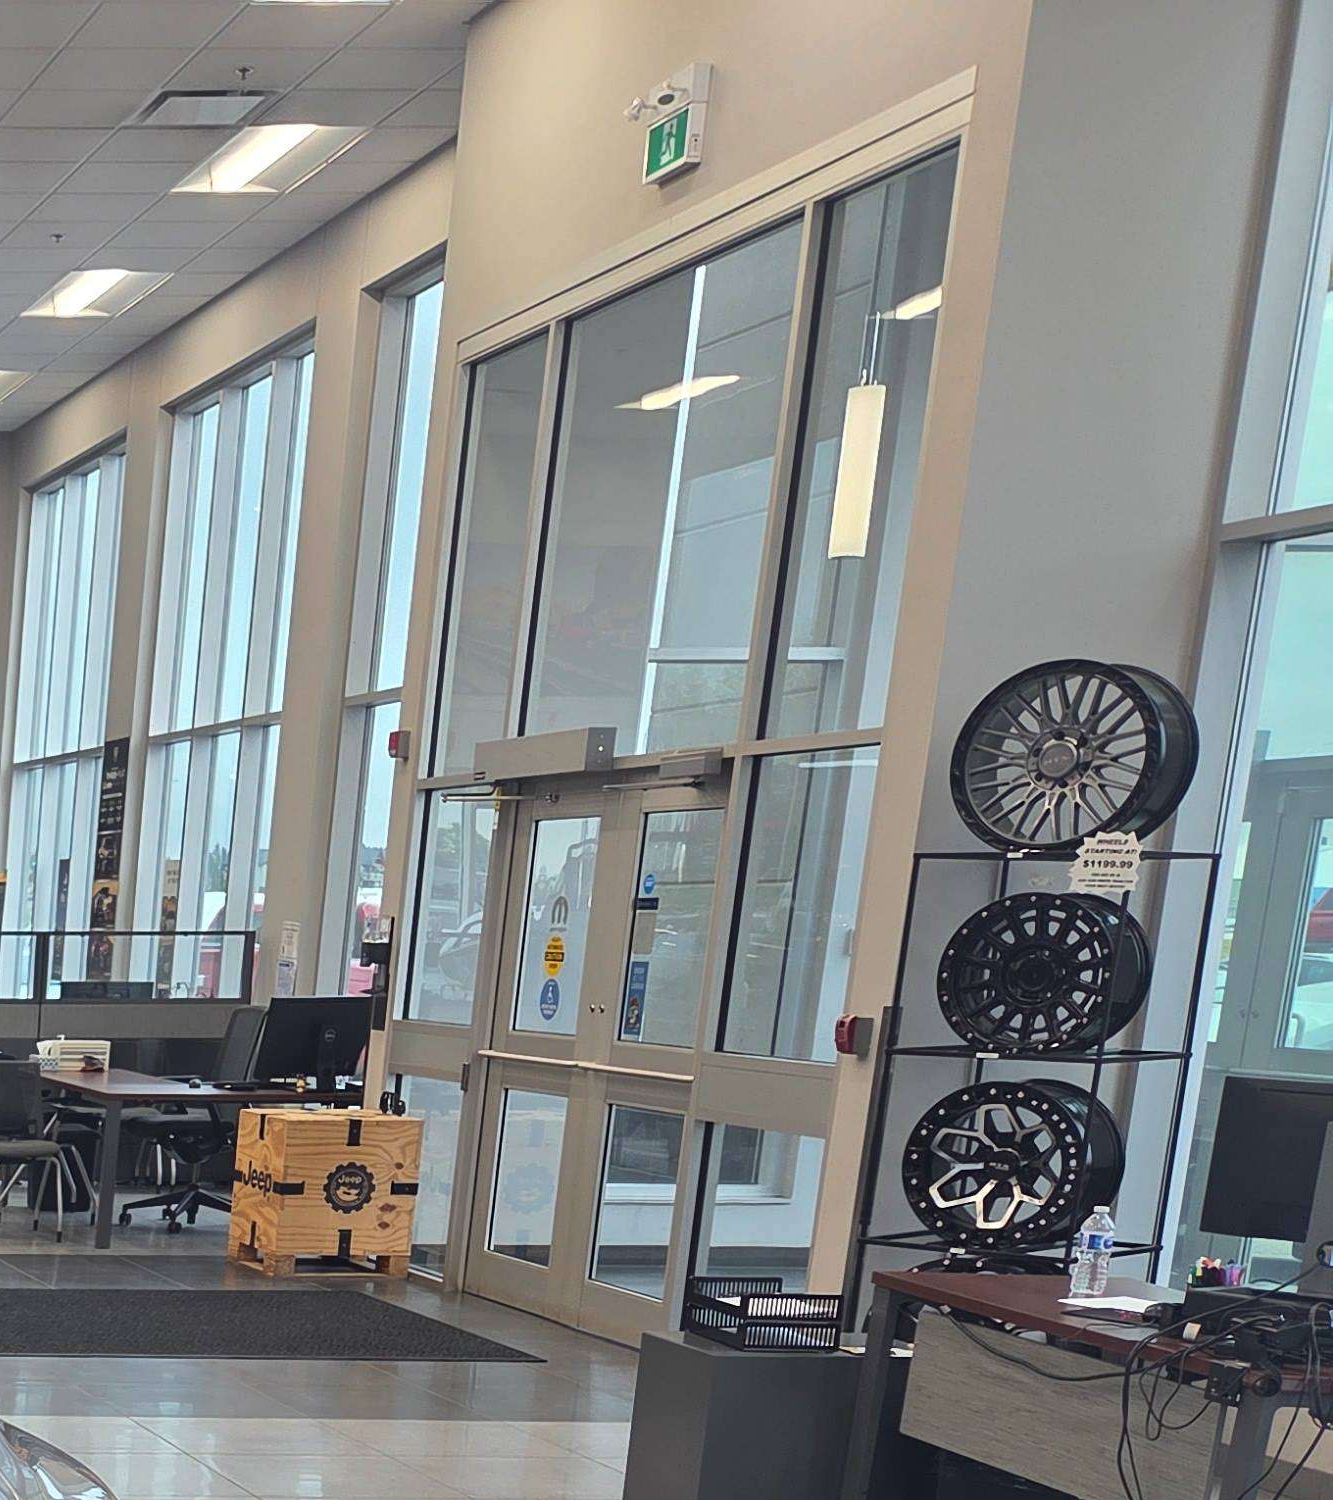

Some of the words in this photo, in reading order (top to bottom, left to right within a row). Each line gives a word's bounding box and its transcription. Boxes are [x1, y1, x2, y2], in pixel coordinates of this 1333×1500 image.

[1083, 859, 1134, 869] $1199.99
[242, 1160, 273, 1197] Jeep
[338, 1174, 363, 1184] Jeep
